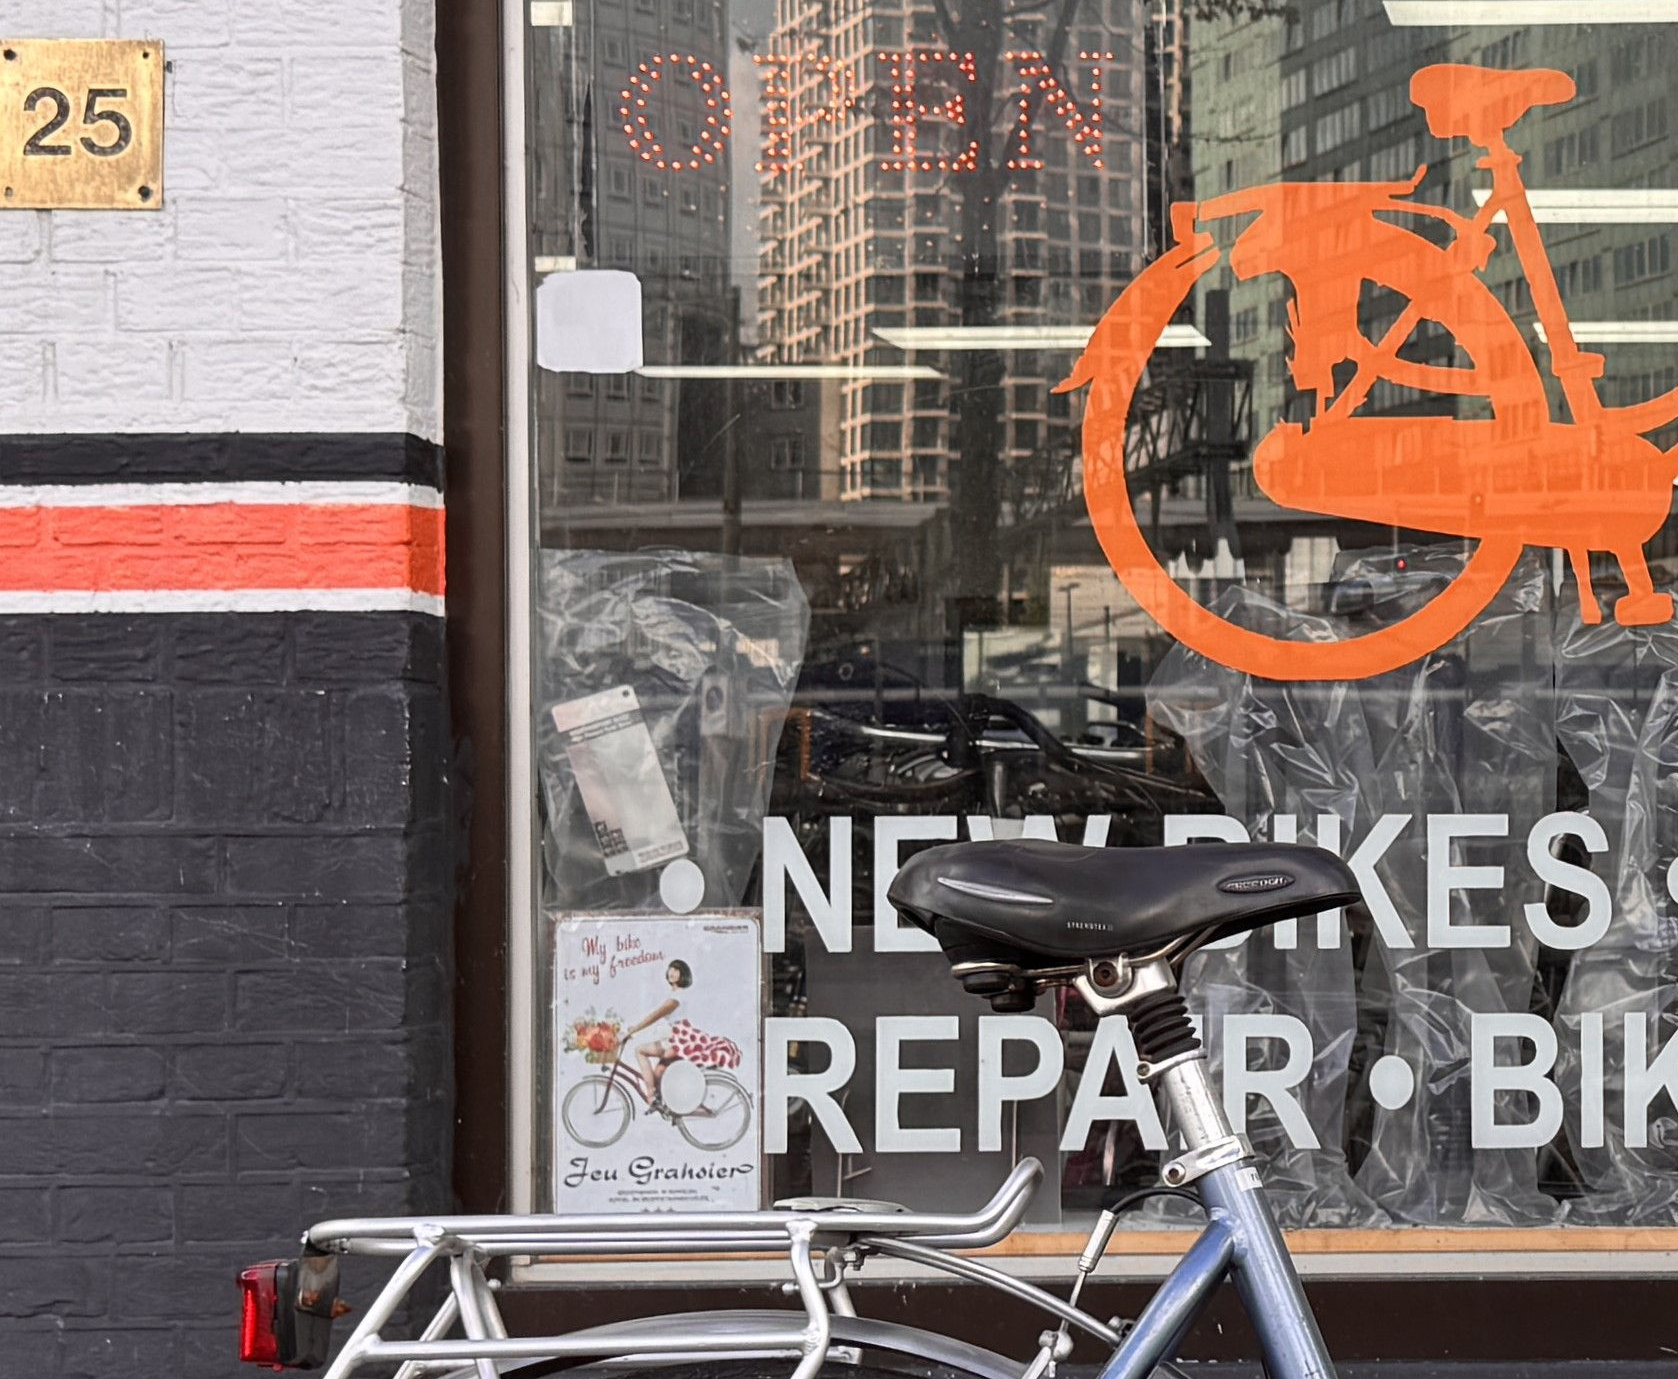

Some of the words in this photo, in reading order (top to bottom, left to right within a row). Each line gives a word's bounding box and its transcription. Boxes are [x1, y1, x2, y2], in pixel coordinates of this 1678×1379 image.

[23, 86, 132, 156] 25
[618, 50, 1116, 170] OPEN
[763, 814, 1112, 954] NE
[564, 966, 576, 981] is
[582, 964, 600, 985] my
[609, 949, 665, 978] freedom
[581, 935, 607, 964] My
[763, 1014, 1322, 1155] REPAR
